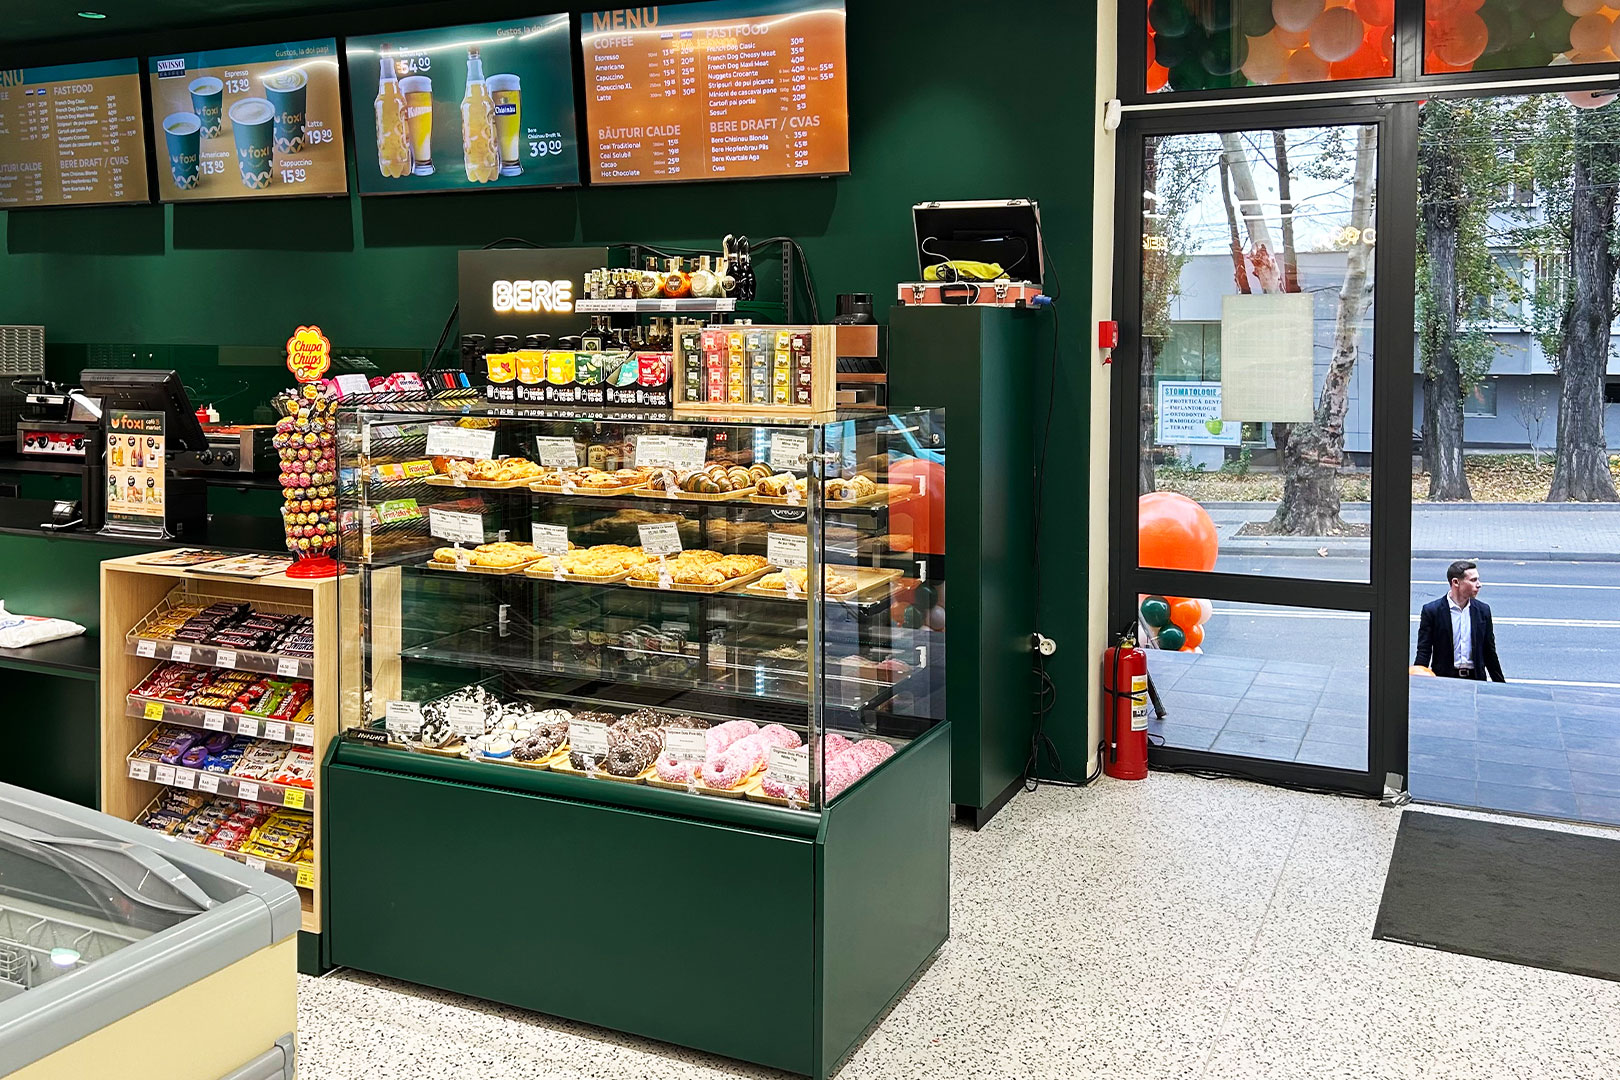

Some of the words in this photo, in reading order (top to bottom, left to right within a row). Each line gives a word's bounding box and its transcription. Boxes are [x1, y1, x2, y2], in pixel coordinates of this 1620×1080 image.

[592, 6, 658, 32] MENU
[706, 27, 732, 38] FAST
[736, 24, 768, 36] FOOD
[594, 36, 634, 49] COFFEE
[594, 54, 619, 62] Espresso
[158, 60, 184, 70] SWISSO
[728, 62, 738, 70] Dog
[225, 70, 249, 78] Espresso
[596, 74, 624, 82] Capuccino
[708, 73, 731, 81] Nuggets
[733, 70, 758, 78] Crocante
[596, 84, 625, 92] Capuccino
[625, 82, 632, 90] XL
[753, 78, 774, 86] picante
[54, 86, 71, 95] FAST
[72, 84, 93, 94] FOOD
[202, 106, 218, 116] foxi
[282, 112, 302, 123] foxi
[710, 121, 738, 133] BERE
[741, 118, 777, 131] DRAFT
[780, 117, 786, 131] /
[790, 116, 820, 128] CVAS
[599, 126, 644, 140] BĂUTURI
[646, 125, 680, 137] CALDE
[612, 142, 640, 150] Traditional
[250, 146, 269, 158] foxi
[60, 160, 78, 169] BERE
[80, 158, 102, 168] DRAFT
[110, 156, 129, 165] CVAS
[179, 154, 196, 163] foxi
[280, 159, 312, 167] Cappuccino
[20, 162, 42, 172] CALDE
[492, 280, 572, 312] BERE
[294, 340, 322, 356] Chupa
[294, 352, 321, 370] Chups
[1165, 388, 1217, 396] STOMATOLOGIE
[121, 414, 144, 429] foxi
[262, 832, 280, 842] Nesquik
